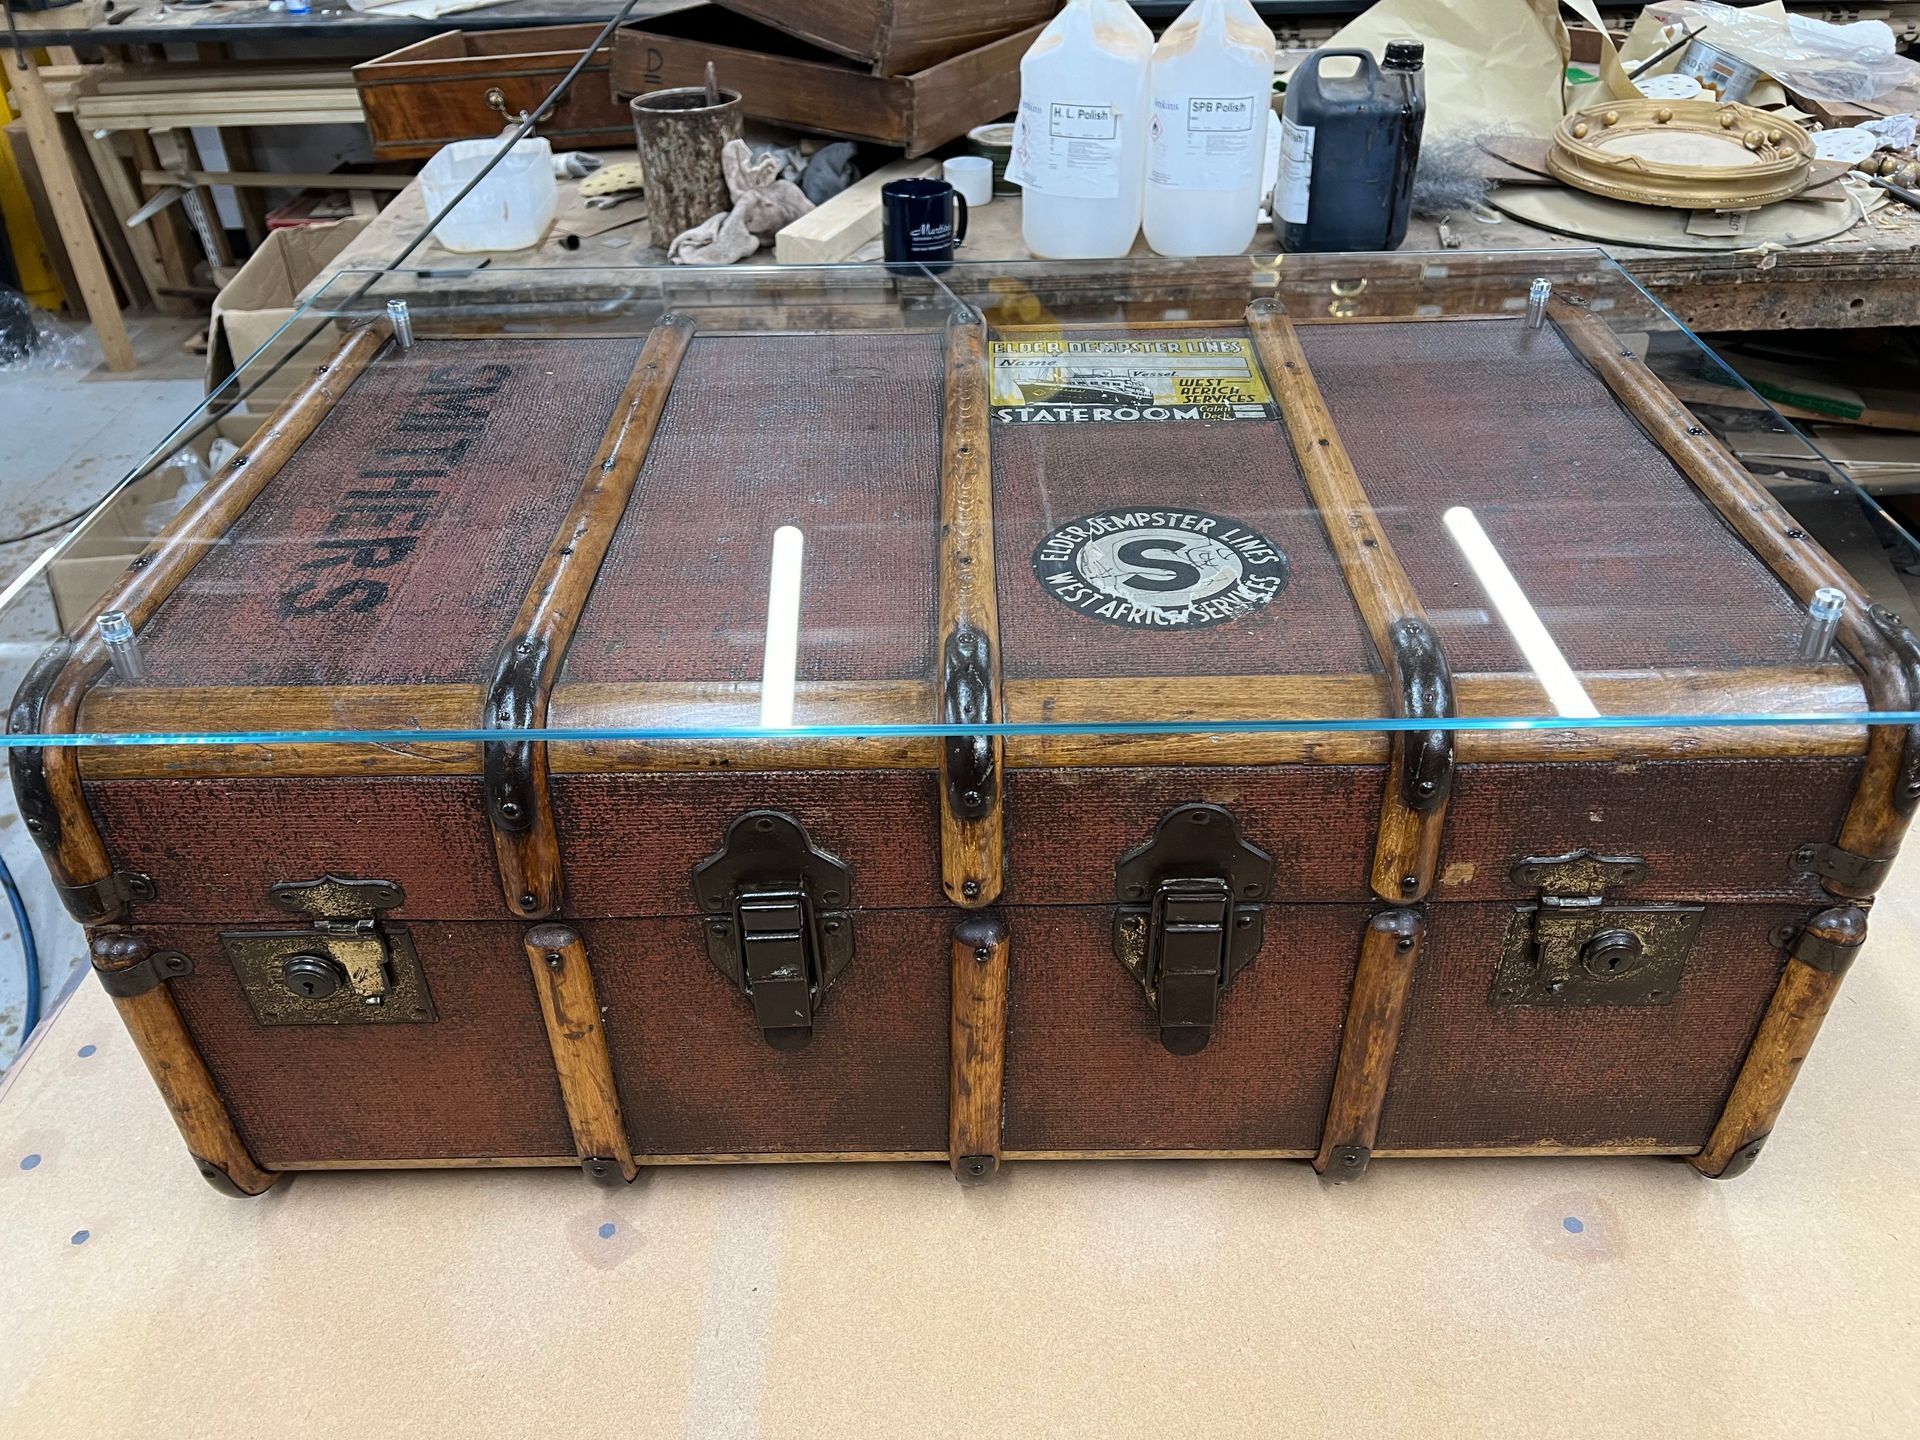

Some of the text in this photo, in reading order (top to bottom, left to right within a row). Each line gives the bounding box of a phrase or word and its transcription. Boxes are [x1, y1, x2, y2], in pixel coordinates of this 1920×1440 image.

[646, 48, 664, 73] D
[1053, 106, 1064, 118] H.
[1066, 108, 1076, 119] L.
[1077, 109, 1108, 121] Polish
[1191, 101, 1247, 113] SPB Polish
[994, 341, 1242, 354] ELDER DEMPSTER LINES
[1179, 378, 1224, 387] WEST
[1183, 395, 1256, 404] SERVICES
[997, 406, 1200, 423] STATEROOM
[277, 363, 513, 620] SMITHERS
[1040, 512, 1280, 564] ELDER DEMPSTER LINES
[1117, 539, 1201, 592] S
[1045, 571, 1105, 608] WEST
[1094, 600, 1190, 625] AFRICA
